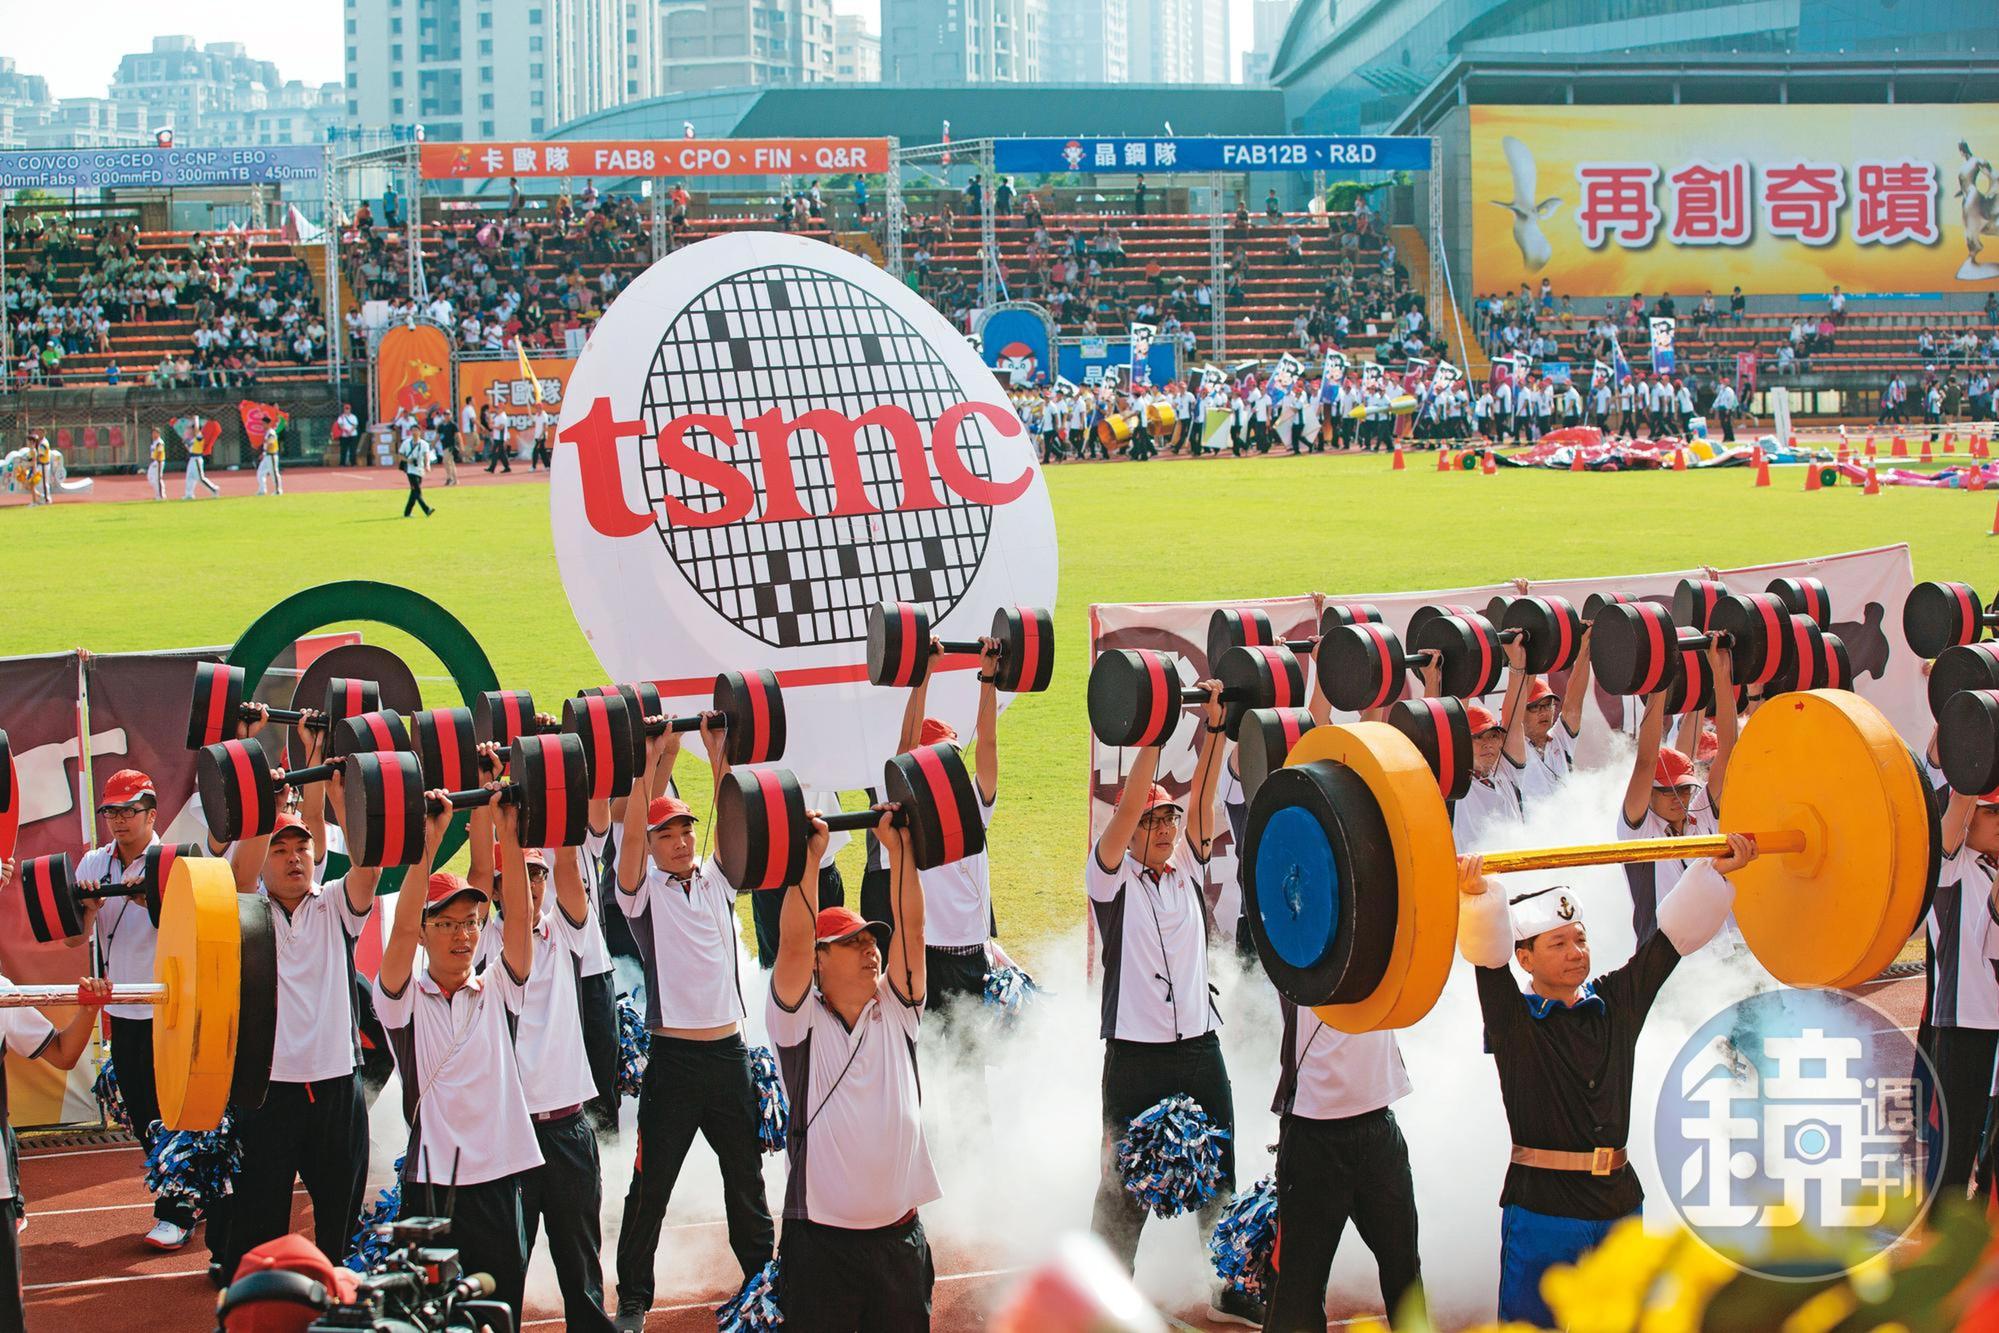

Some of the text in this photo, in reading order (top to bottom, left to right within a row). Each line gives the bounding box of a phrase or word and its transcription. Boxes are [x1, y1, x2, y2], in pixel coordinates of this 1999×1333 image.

[480, 147, 570, 173] 卡歐隊
[815, 147, 867, 169] Q&R
[1095, 142, 1177, 166] 晶鋼隊
[1330, 144, 1377, 164] R&D
[265, 165, 318, 179] 450mm
[1577, 159, 1937, 246] 再創奇蹟
[559, 397, 1034, 537] tsmc
